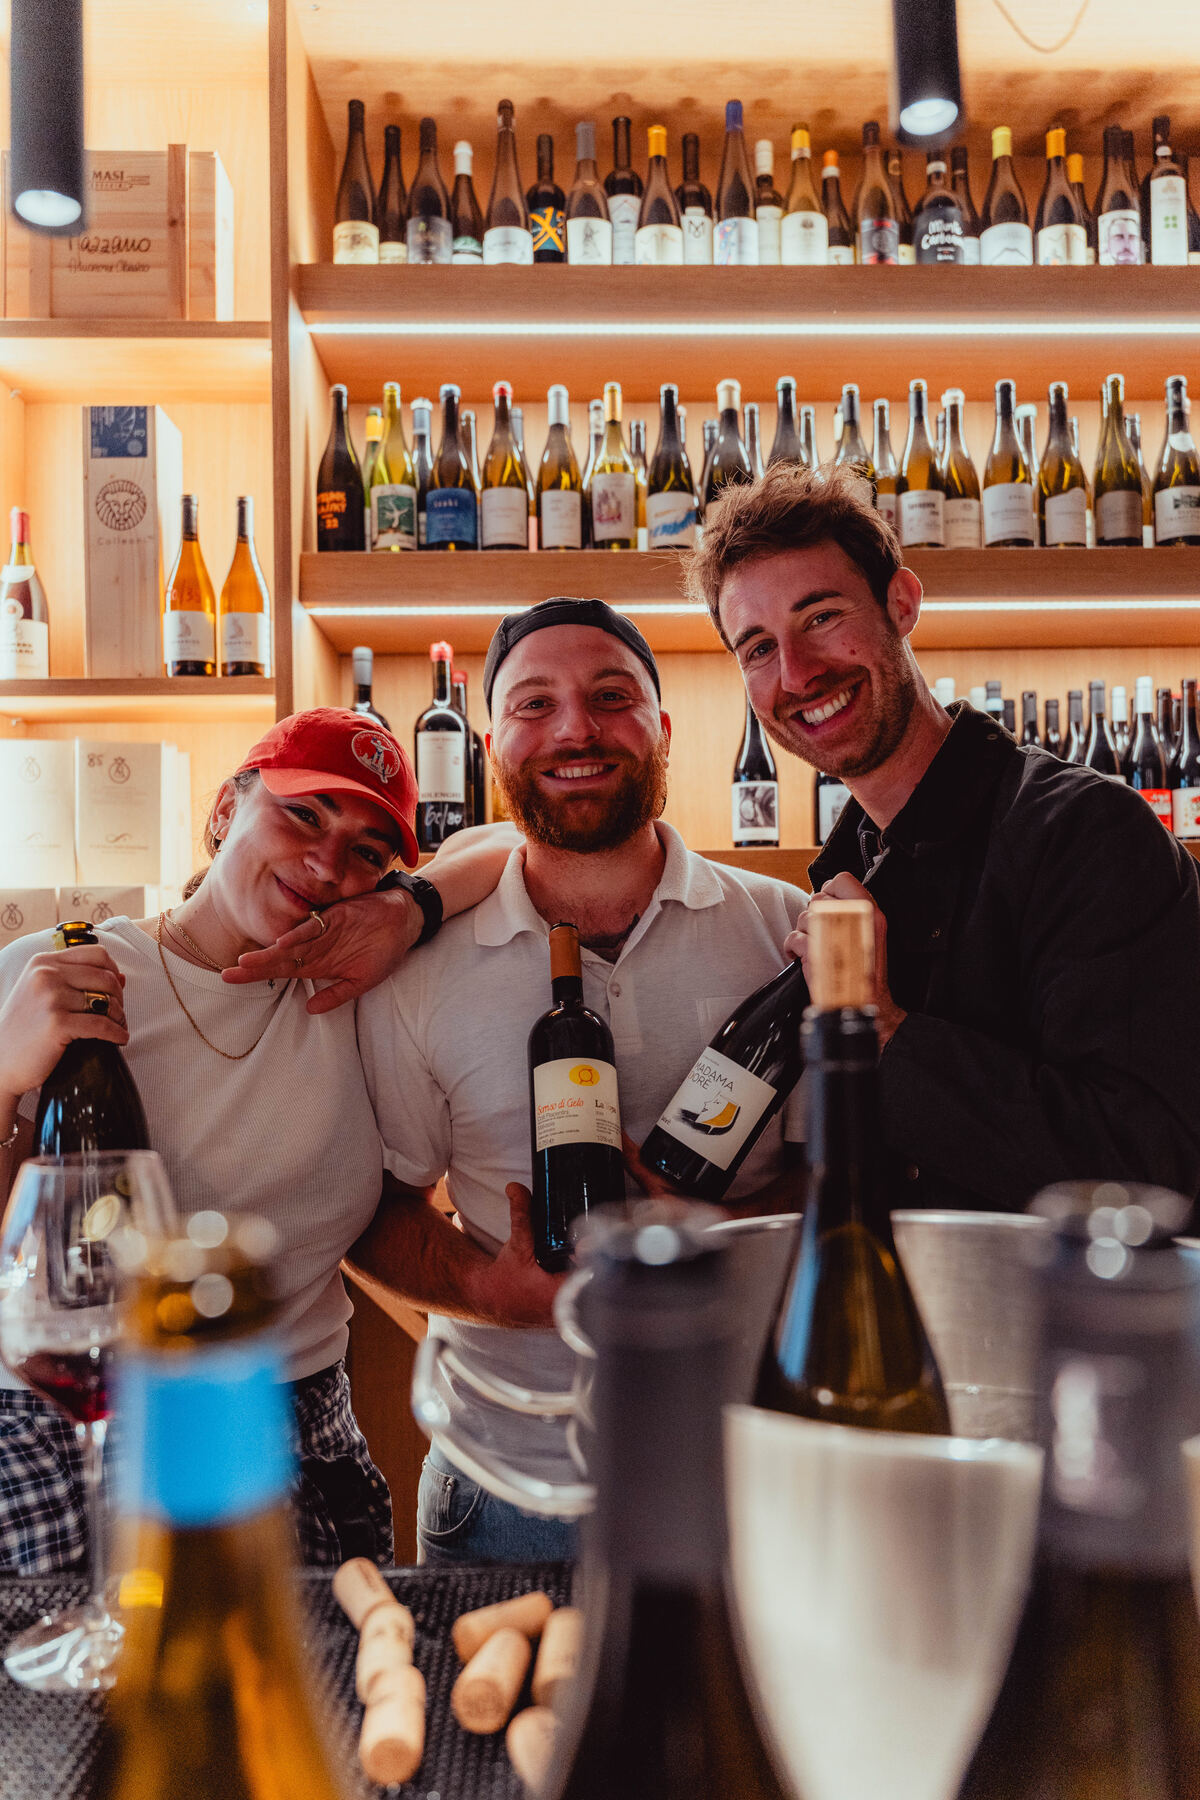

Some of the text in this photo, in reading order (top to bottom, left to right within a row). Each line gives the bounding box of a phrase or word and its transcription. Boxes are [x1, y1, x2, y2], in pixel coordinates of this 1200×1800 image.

[93, 170, 124, 181] MASI
[696, 1060, 735, 1093] MADAMA
[595, 1099, 605, 1109] La
